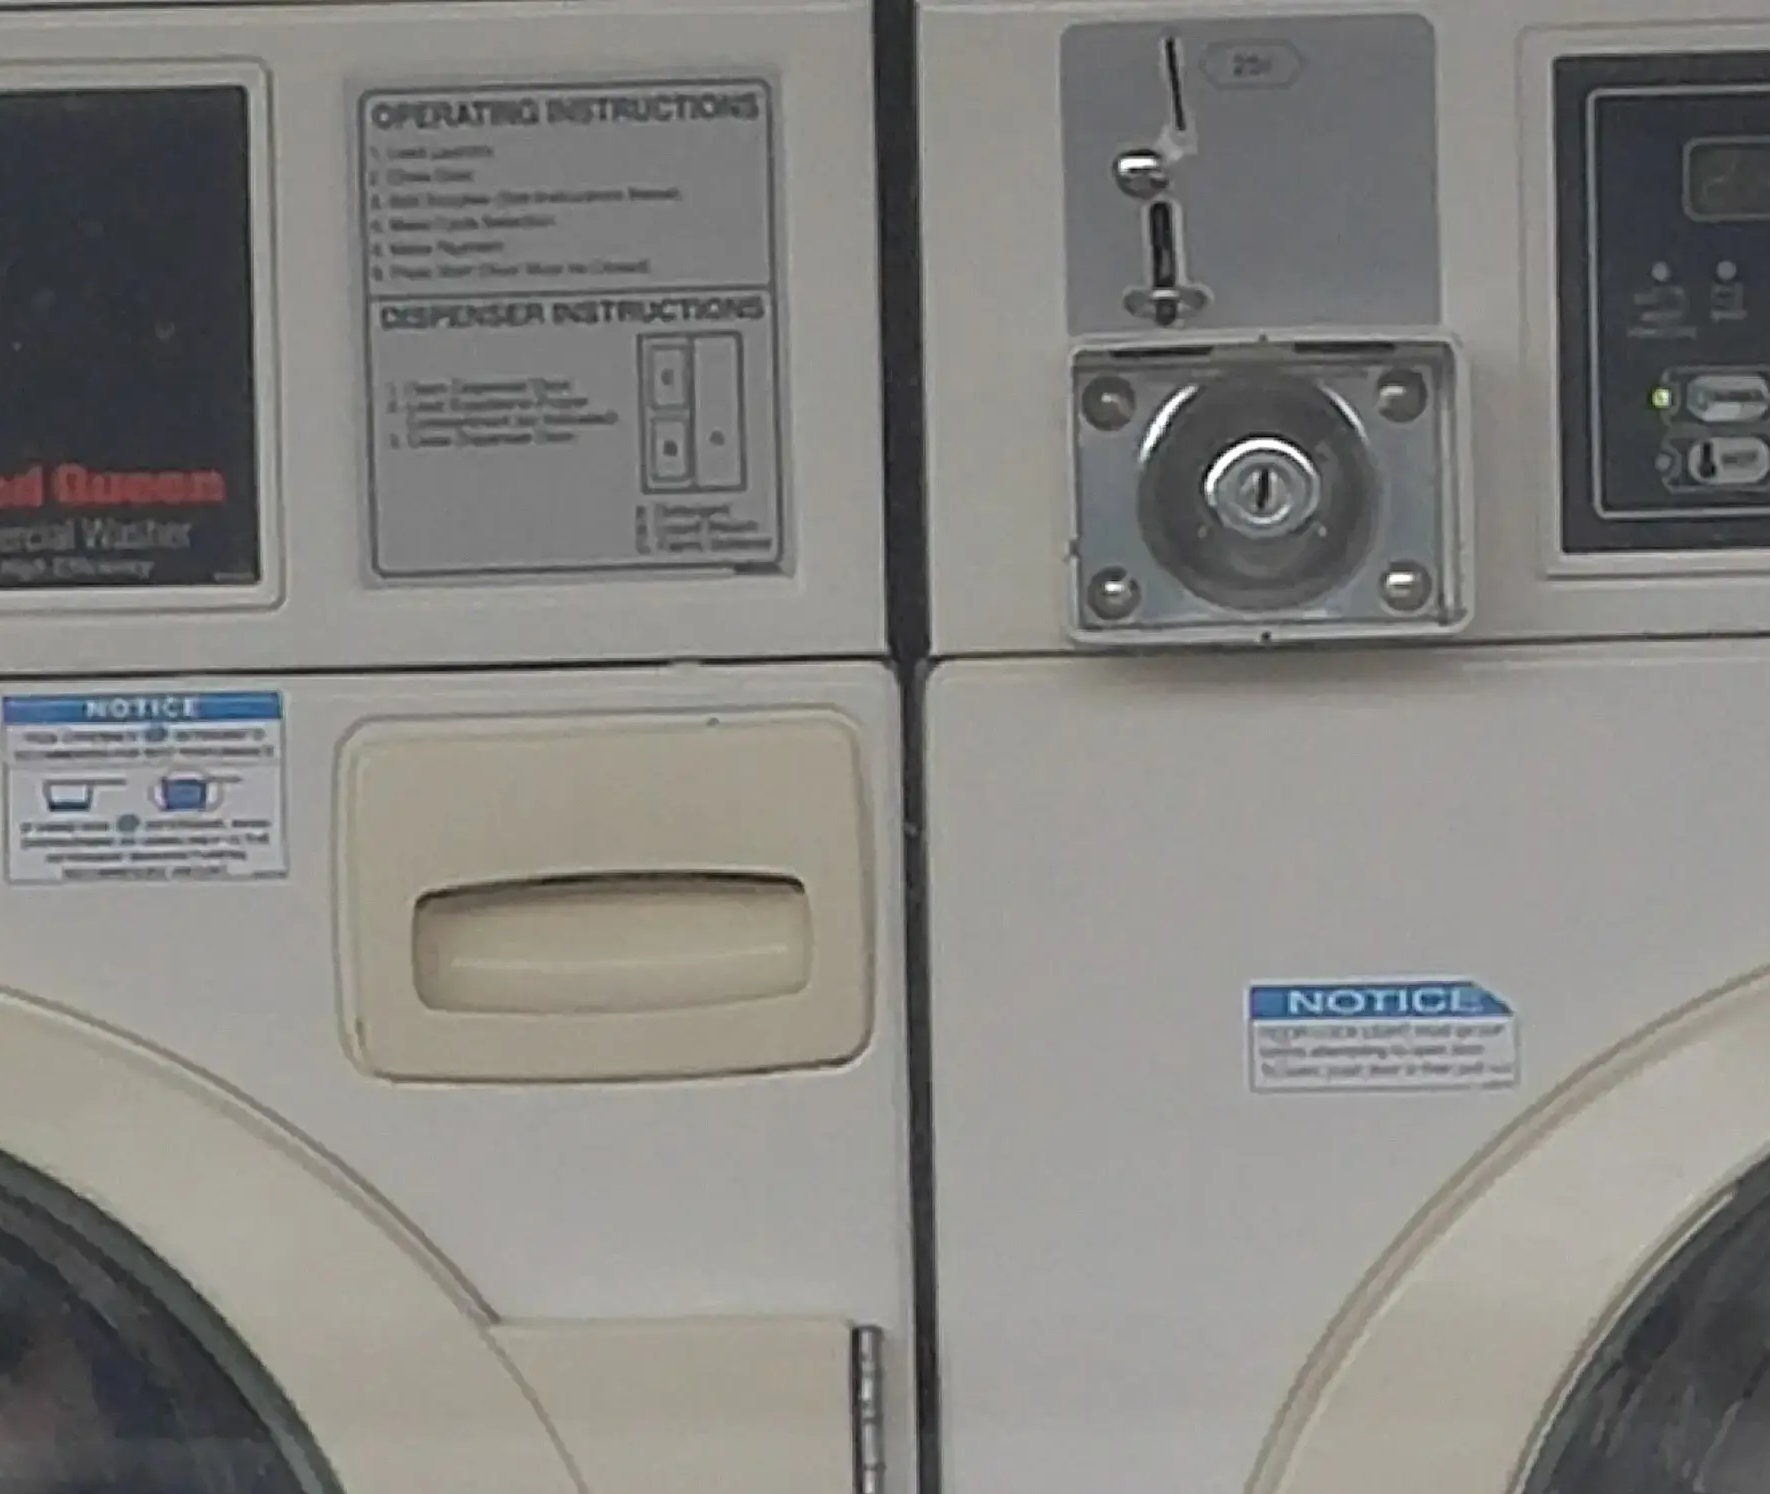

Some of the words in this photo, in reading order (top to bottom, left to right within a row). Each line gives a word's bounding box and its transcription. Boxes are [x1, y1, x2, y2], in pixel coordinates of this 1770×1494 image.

[372, 98, 539, 129] OPERATING
[546, 92, 759, 124] INSTRUCTIONS
[380, 302, 544, 329] DISPENSER
[553, 296, 765, 326] INSTRUCTIONS
[55, 462, 226, 507] Queen
[82, 517, 193, 550] Washer
[85, 696, 200, 719] NOTICE
[1287, 988, 1485, 1015] NOTICE
